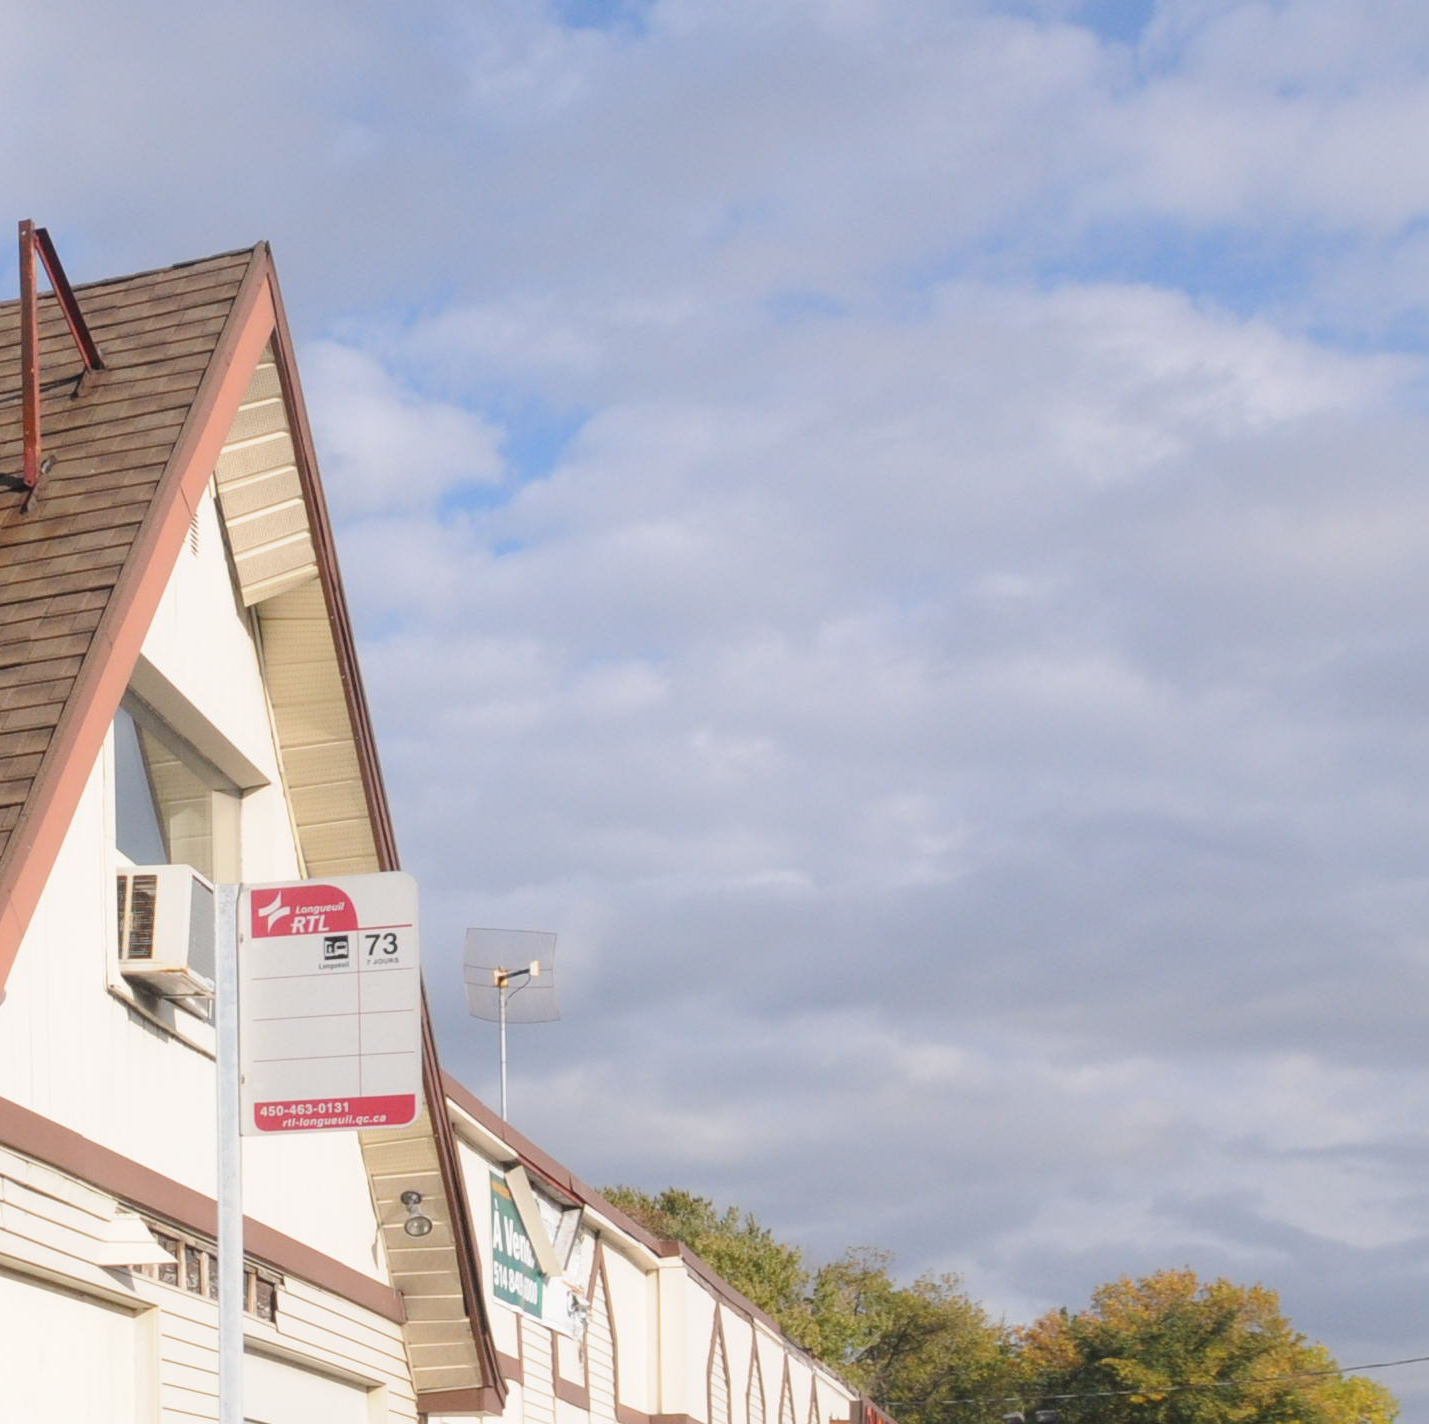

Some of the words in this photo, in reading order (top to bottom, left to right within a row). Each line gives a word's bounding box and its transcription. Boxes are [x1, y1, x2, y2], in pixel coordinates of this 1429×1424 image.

[295, 901, 345, 914] Longueuil
[290, 914, 331, 934] RTL
[364, 932, 398, 956] 73
[260, 1101, 350, 1117] 450-463-0131
[282, 1114, 387, 1128] rtl-longueuil.qc.ca
[493, 1260, 508, 1290] 514
